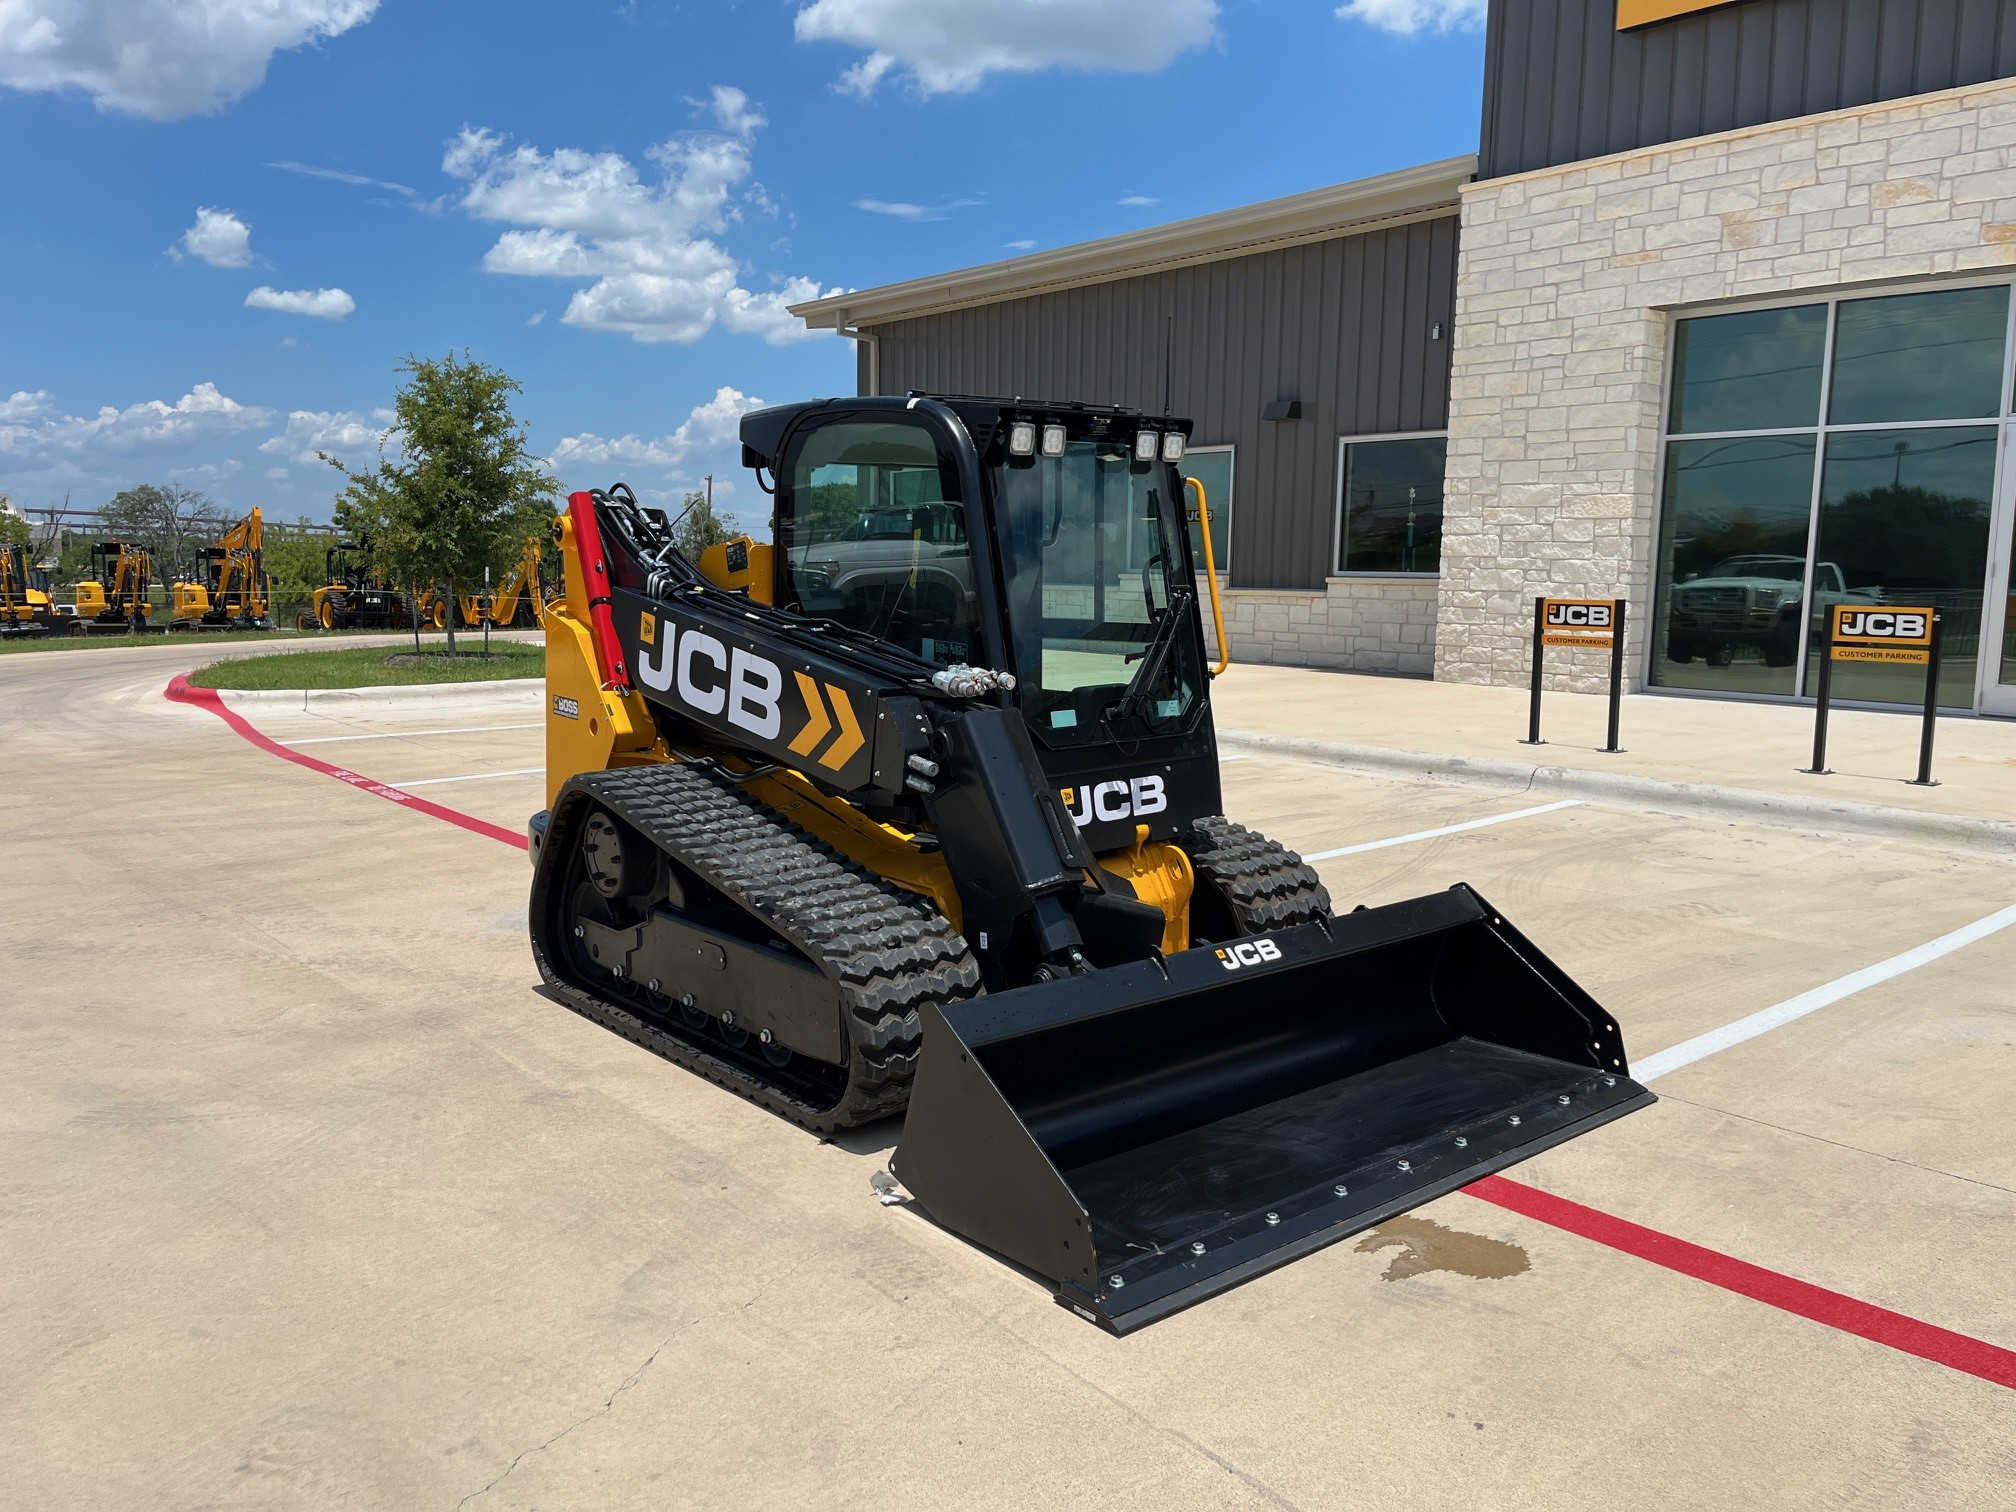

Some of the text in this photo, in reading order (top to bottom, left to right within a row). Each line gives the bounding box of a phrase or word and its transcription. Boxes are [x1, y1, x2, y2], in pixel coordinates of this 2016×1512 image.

[1548, 605, 1610, 626] JCB
[1841, 613, 1924, 637] JCB
[1581, 638, 1609, 646] PARKING
[1838, 650, 1922, 661] CUSTOMER PARKING
[638, 620, 782, 740] JCB
[558, 698, 578, 714] BOSS
[1067, 775, 1167, 827] JCB
[1221, 939, 1282, 970] JCB
